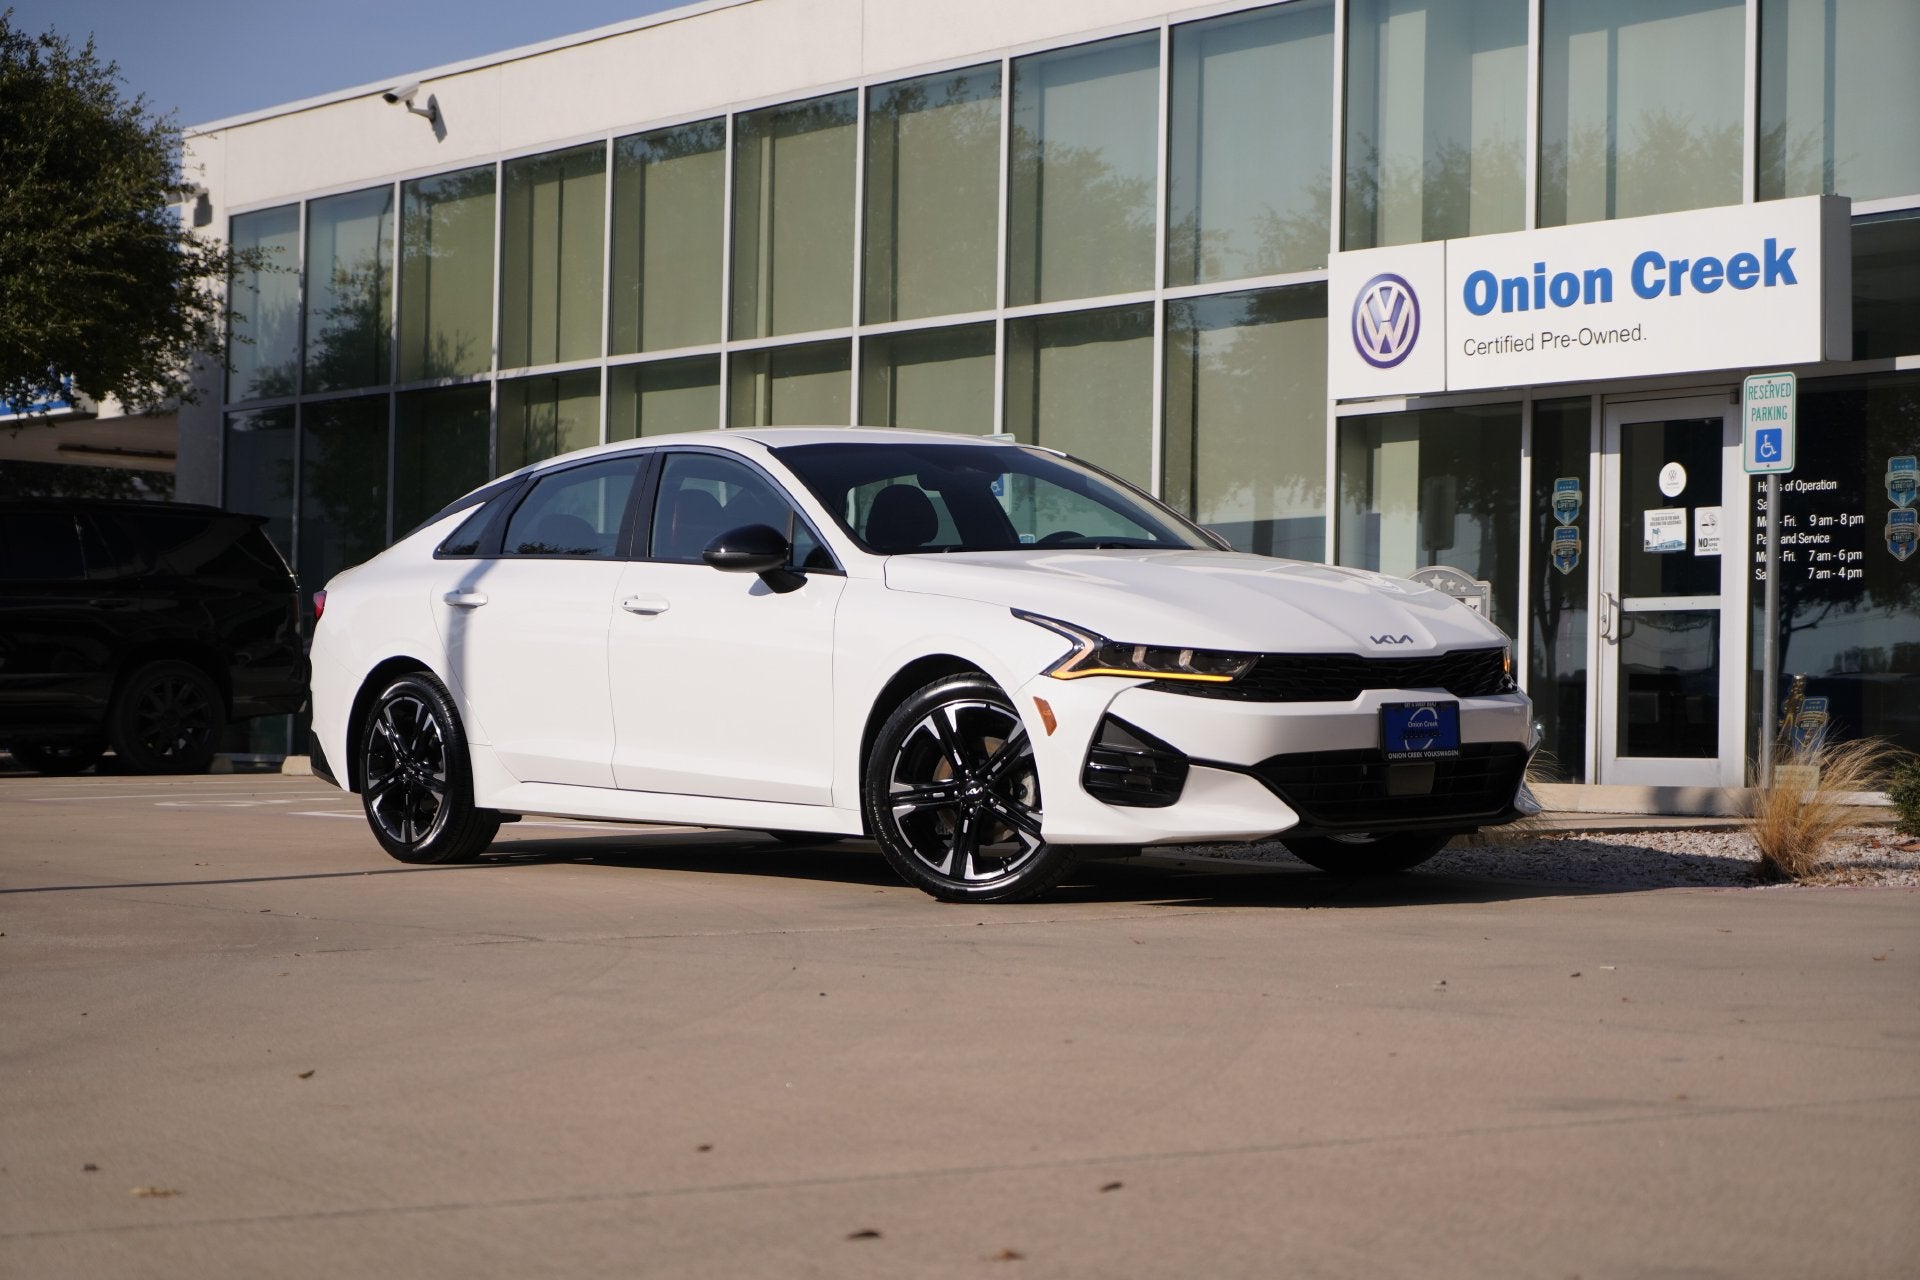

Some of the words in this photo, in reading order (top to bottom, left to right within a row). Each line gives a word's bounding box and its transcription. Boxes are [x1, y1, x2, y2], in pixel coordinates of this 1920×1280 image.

[1463, 262, 1613, 316] Onion
[1631, 237, 1798, 300] Creek
[1463, 332, 1535, 357] Certified
[1541, 323, 1648, 350] Pre-Owned.
[1748, 382, 1792, 401] RESERVED
[1751, 405, 1788, 422] PARKING
[1785, 481, 1794, 492] of
[1795, 480, 1837, 494] Operation
[1784, 515, 1797, 527] Fri.
[1809, 514, 1816, 526] 9
[1818, 517, 1833, 526] am
[1840, 514, 1847, 525] 8
[1849, 515, 1864, 528] pm
[1780, 533, 1796, 544] and
[1798, 532, 1830, 544] Service
[1783, 550, 1796, 562] Fri.
[1808, 550, 1815, 561] 7
[1817, 552, 1831, 561] am
[1838, 549, 1845, 560] 6
[1847, 551, 1862, 563] pm
[1808, 568, 1814, 579] 7
[1816, 570, 1830, 579] am
[1838, 566, 1845, 578] 4
[1847, 568, 1862, 580] pm
[1370, 634, 1414, 645] KIA
[1388, 752, 1407, 760] ONION
[1424, 750, 1459, 758] VOLKSWAGEN
